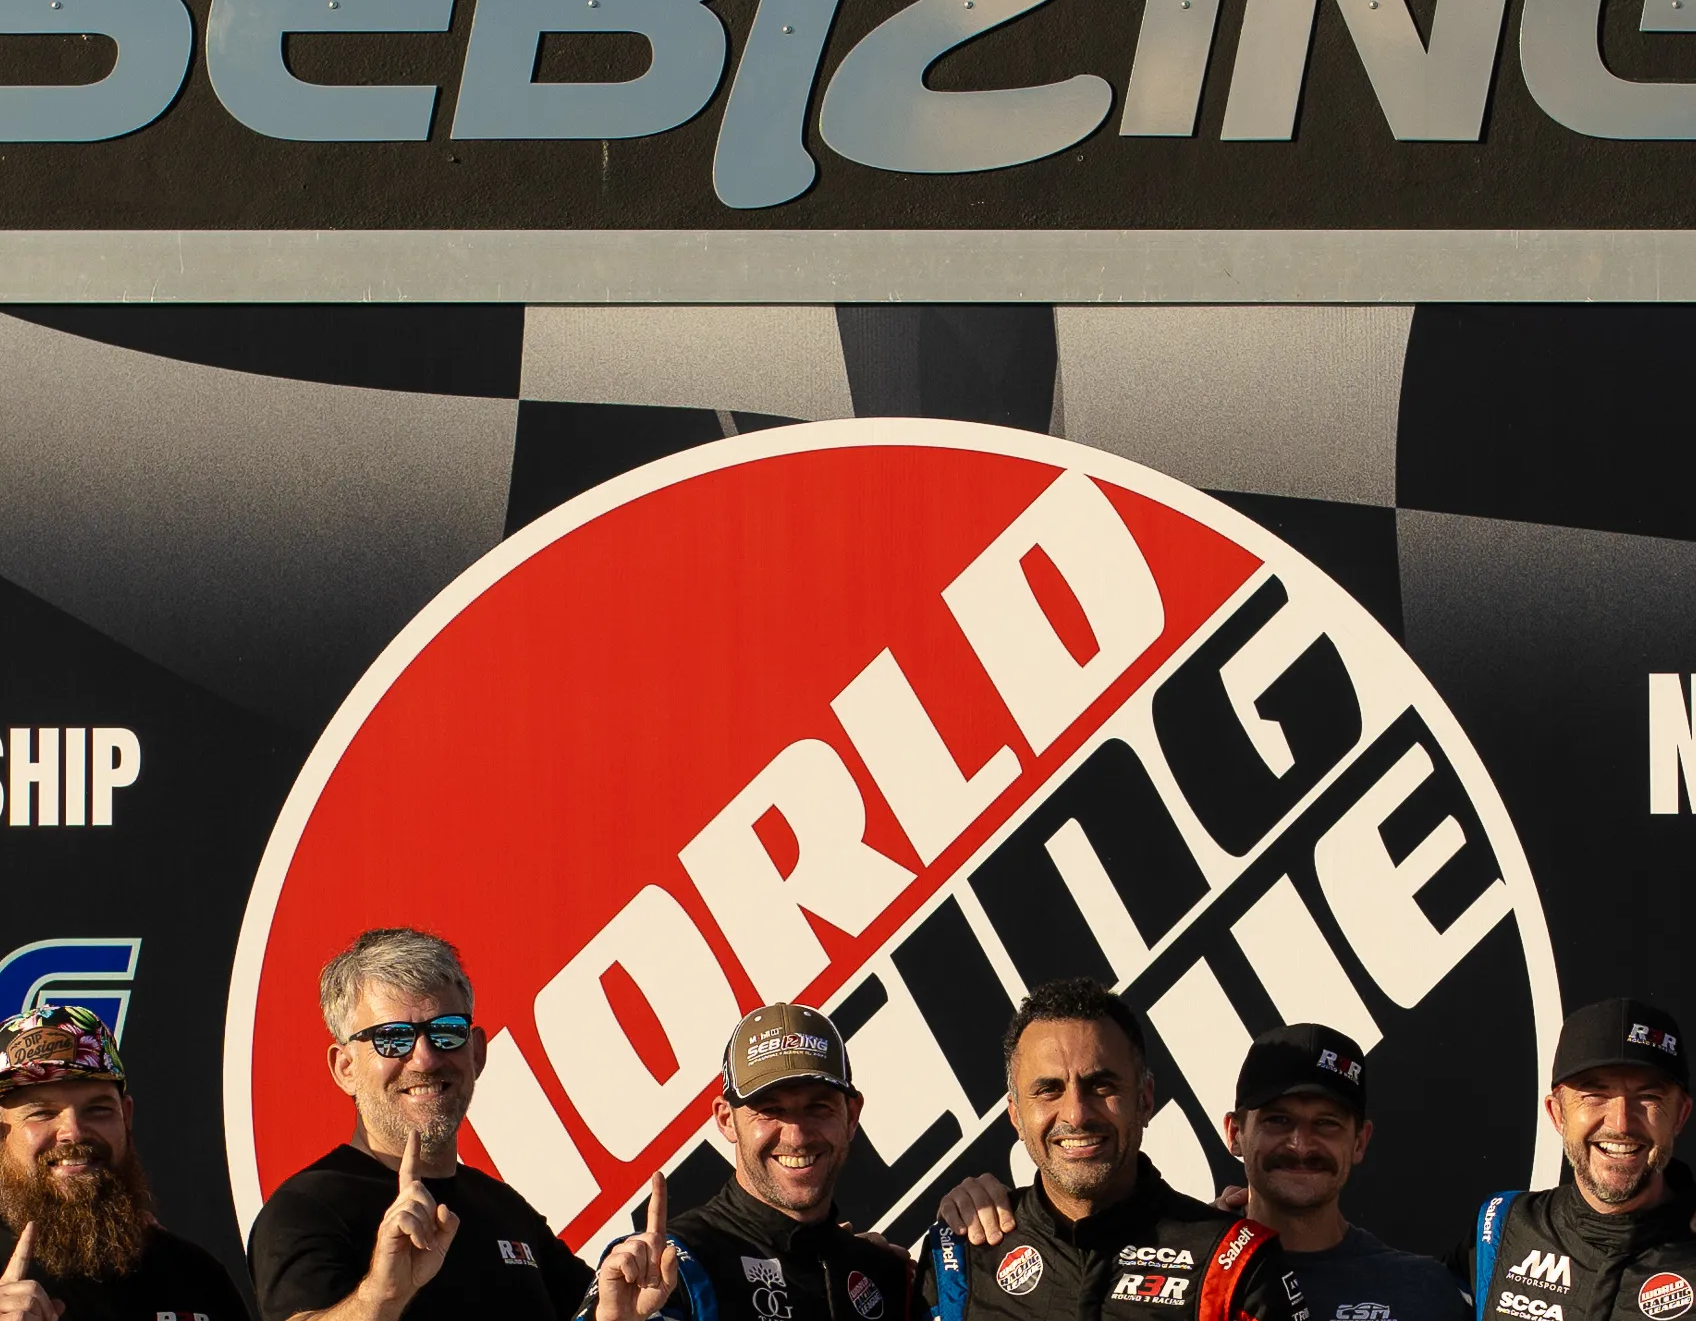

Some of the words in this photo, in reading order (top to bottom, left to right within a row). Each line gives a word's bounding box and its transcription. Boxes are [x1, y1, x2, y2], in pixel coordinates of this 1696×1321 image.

[939, 1227, 959, 1271] Sabelt
[1119, 1244, 1194, 1265] SCCA
[1218, 1226, 1255, 1271] Sabelt
[1113, 1273, 1190, 1300] R3R
[1506, 1272, 1571, 1295] MOTORSPORT
[1641, 1280, 1685, 1302] WORLD
[1111, 1293, 1142, 1302] ROUND
[1143, 1295, 1151, 1303] 3
[1152, 1295, 1186, 1306] RACING
[1499, 1291, 1563, 1321] SCCA
